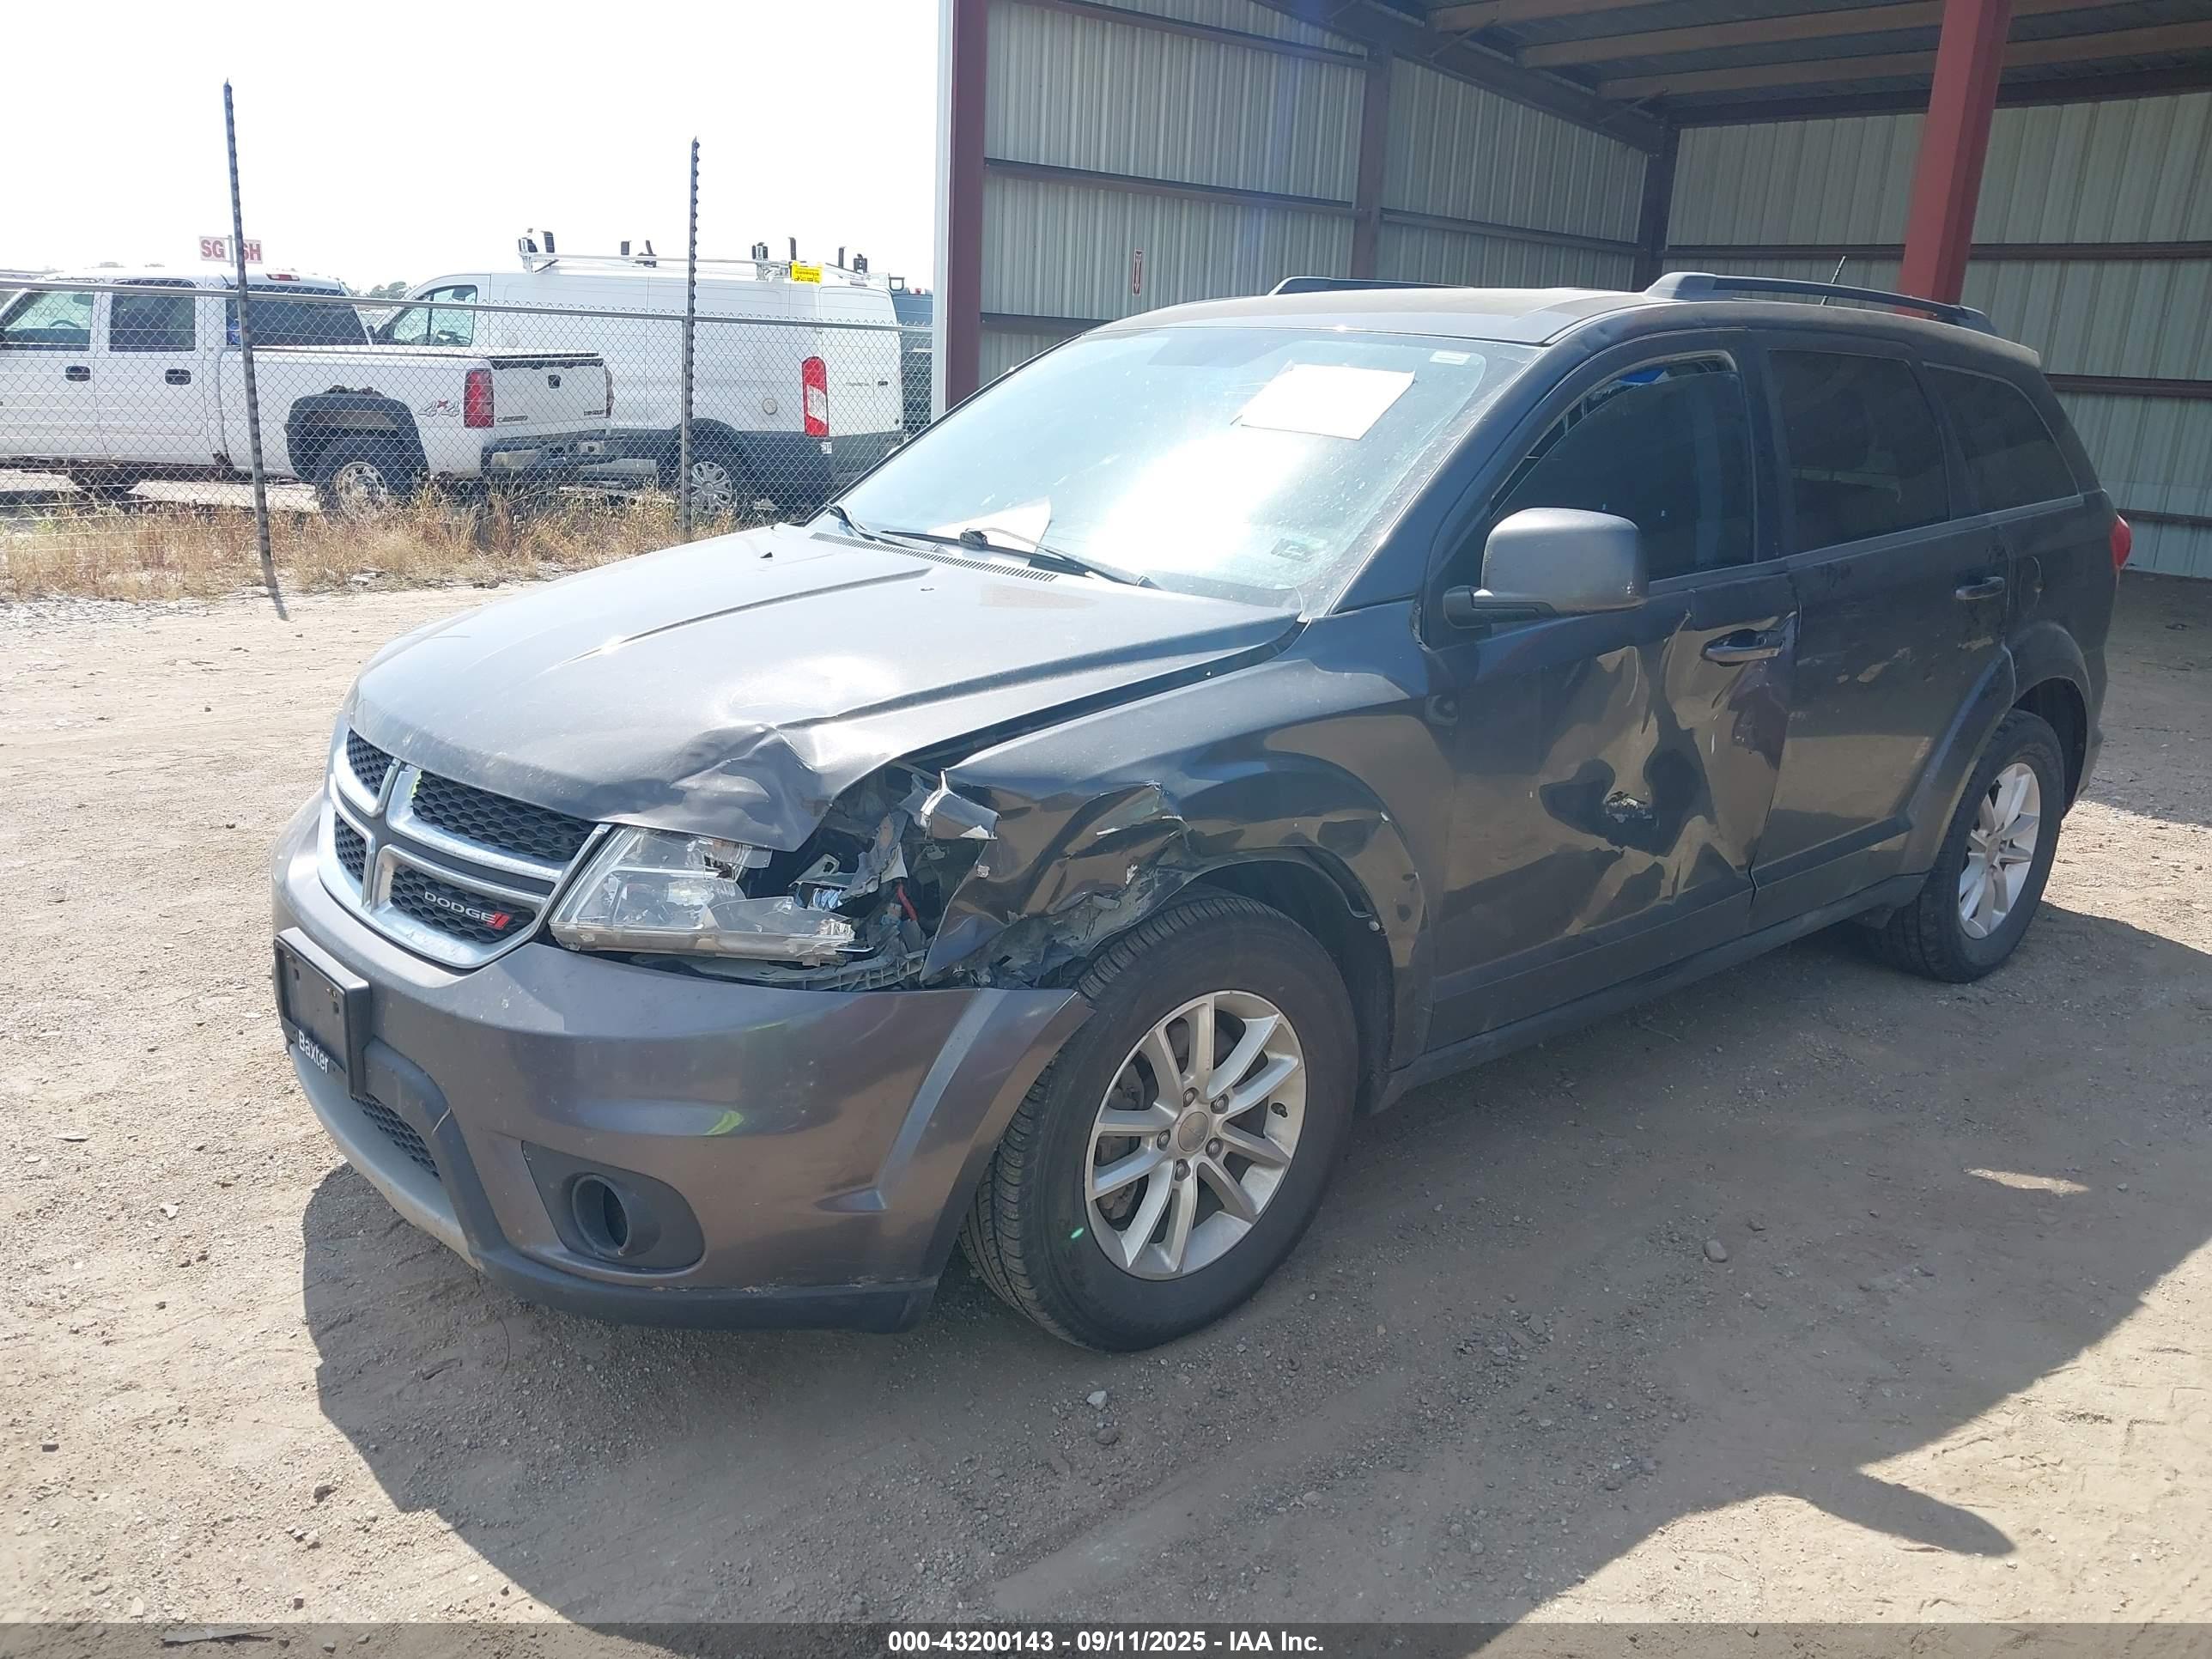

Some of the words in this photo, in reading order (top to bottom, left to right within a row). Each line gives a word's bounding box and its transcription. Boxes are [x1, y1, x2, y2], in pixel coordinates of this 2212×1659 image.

[200, 239, 225, 258] SG
[425, 890, 497, 925] DODGE
[298, 1030, 330, 1074] Baxter
